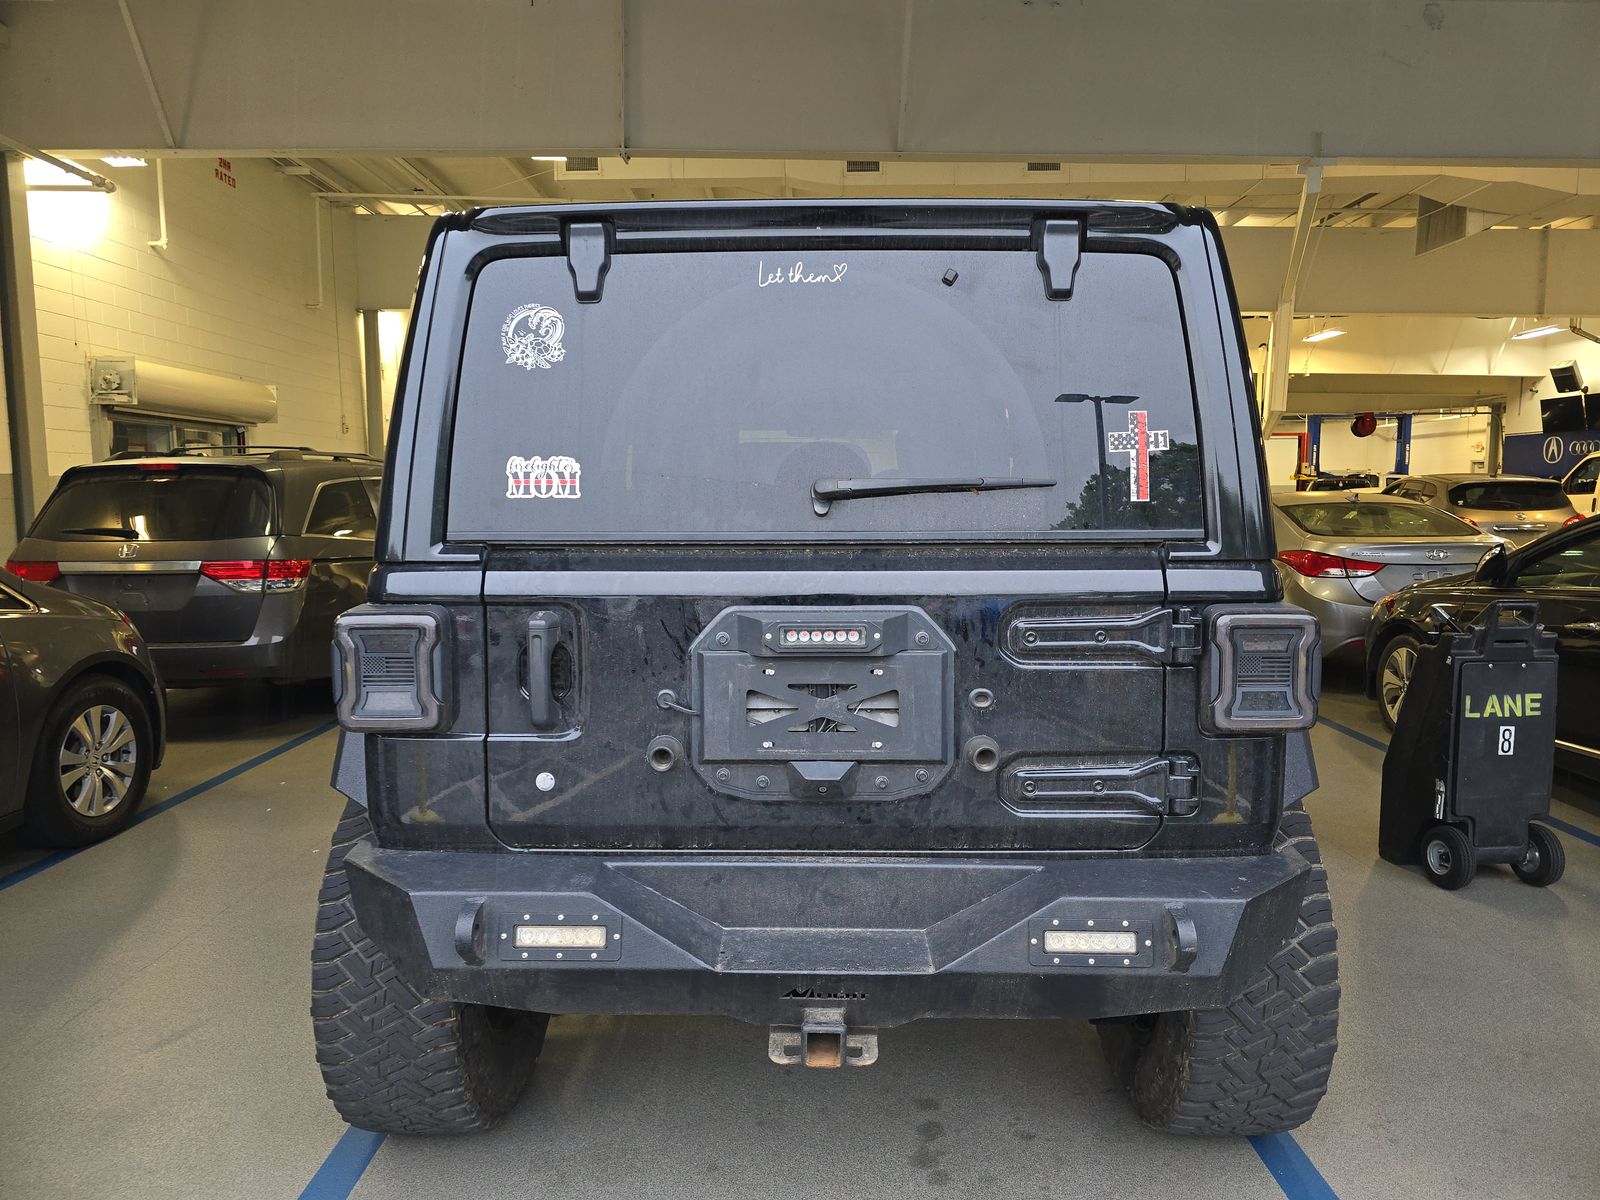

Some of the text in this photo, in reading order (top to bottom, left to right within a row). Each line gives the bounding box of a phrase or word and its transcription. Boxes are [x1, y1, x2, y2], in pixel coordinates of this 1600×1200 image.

[214, 168, 237, 189] RATED
[758, 260, 834, 287] Let them
[507, 471, 581, 497] MOM
[1464, 693, 1543, 719] LANE
[1501, 728, 1513, 754] 8
